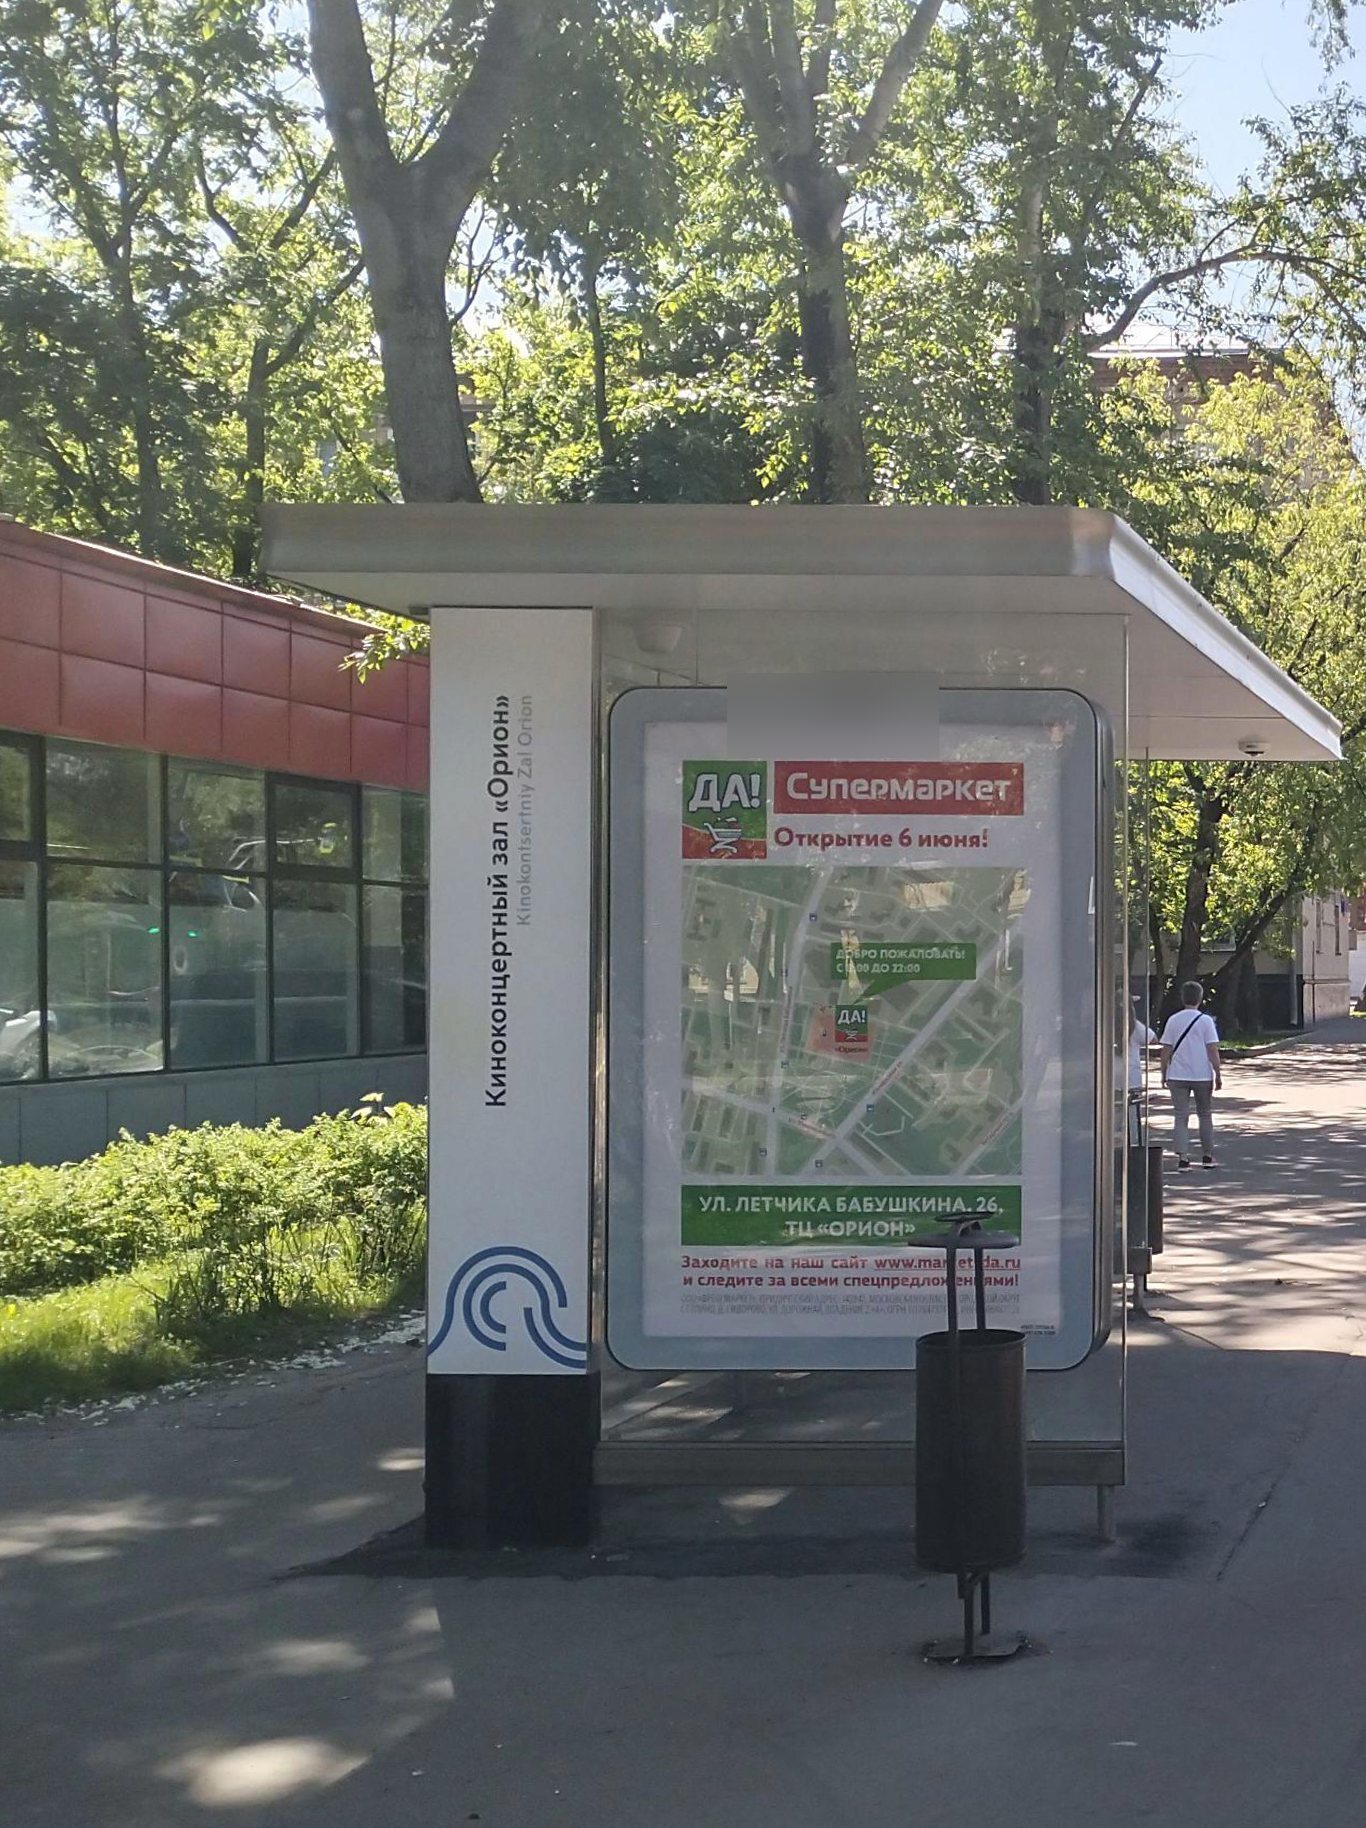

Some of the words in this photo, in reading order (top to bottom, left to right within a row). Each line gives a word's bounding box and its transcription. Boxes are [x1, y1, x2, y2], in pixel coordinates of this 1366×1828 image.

[517, 695, 532, 746] Orion
[487, 695, 514, 812] «Орион»
[517, 752, 532, 779] Zal
[688, 773, 761, 812] ДА!
[786, 772, 1011, 801] Супермаркет
[492, 822, 508, 865] зал
[773, 826, 893, 851] Открытие
[898, 828, 912, 848] 6
[918, 828, 988, 848] июня!
[516, 783, 535, 925] Kinokontsertniy
[836, 949, 878, 960] ДОБРО
[880, 948, 965, 960] ПОЖАЛОВАТЬ!
[871, 963, 889, 974] ДО
[892, 963, 921, 973] 22:00
[485, 873, 513, 1106] Киноконцертный
[837, 1009, 866, 1024] ДА!
[700, 1197, 731, 1212] УЛ.
[735, 1197, 831, 1212] ЛЕТЧИКА
[976, 1196, 1004, 1215] 26,
[785, 1221, 813, 1237] ТЦ
[817, 1221, 916, 1236] «ОРИОН»
[681, 1255, 758, 1270] Заходите
[765, 1258, 784, 1269] на
[791, 1258, 824, 1269] наш
[831, 1255, 868, 1269] сайт
[874, 1255, 1021, 1271] www.maretda.ru
[683, 1275, 693, 1286] и
[698, 1275, 764, 1288] следите
[768, 1275, 786, 1286] за
[791, 1275, 838, 1286] всеми
